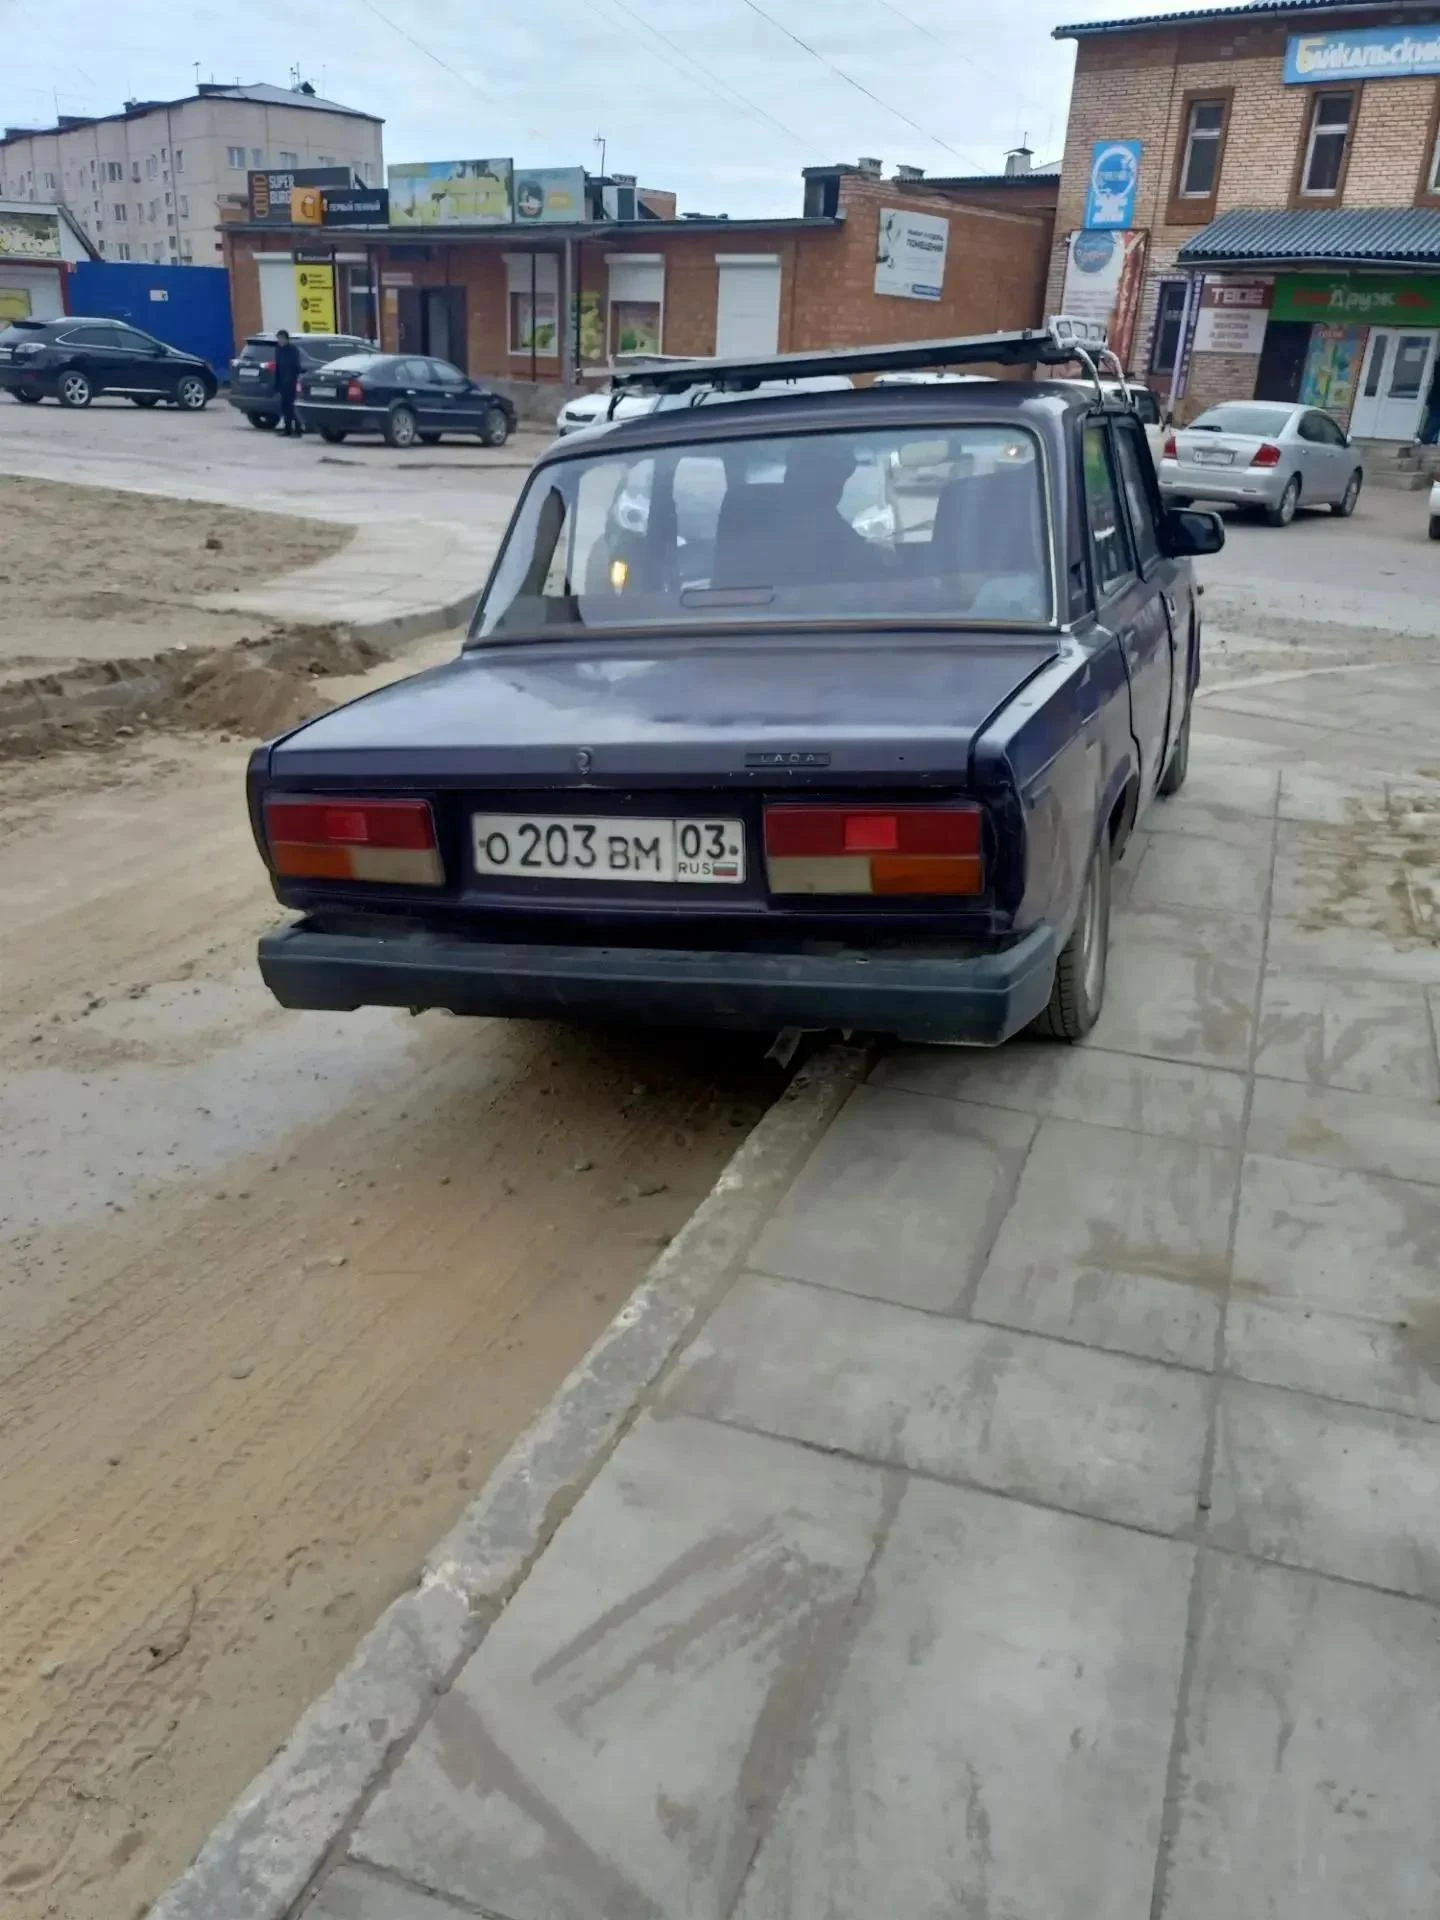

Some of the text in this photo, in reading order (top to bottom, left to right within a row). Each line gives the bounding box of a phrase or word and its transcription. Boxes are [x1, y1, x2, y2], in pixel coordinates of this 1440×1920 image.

[269, 174, 294, 189] SUPER
[760, 753, 816, 763] LADA
[681, 824, 726, 859] 03
[678, 861, 711, 875] RUS
